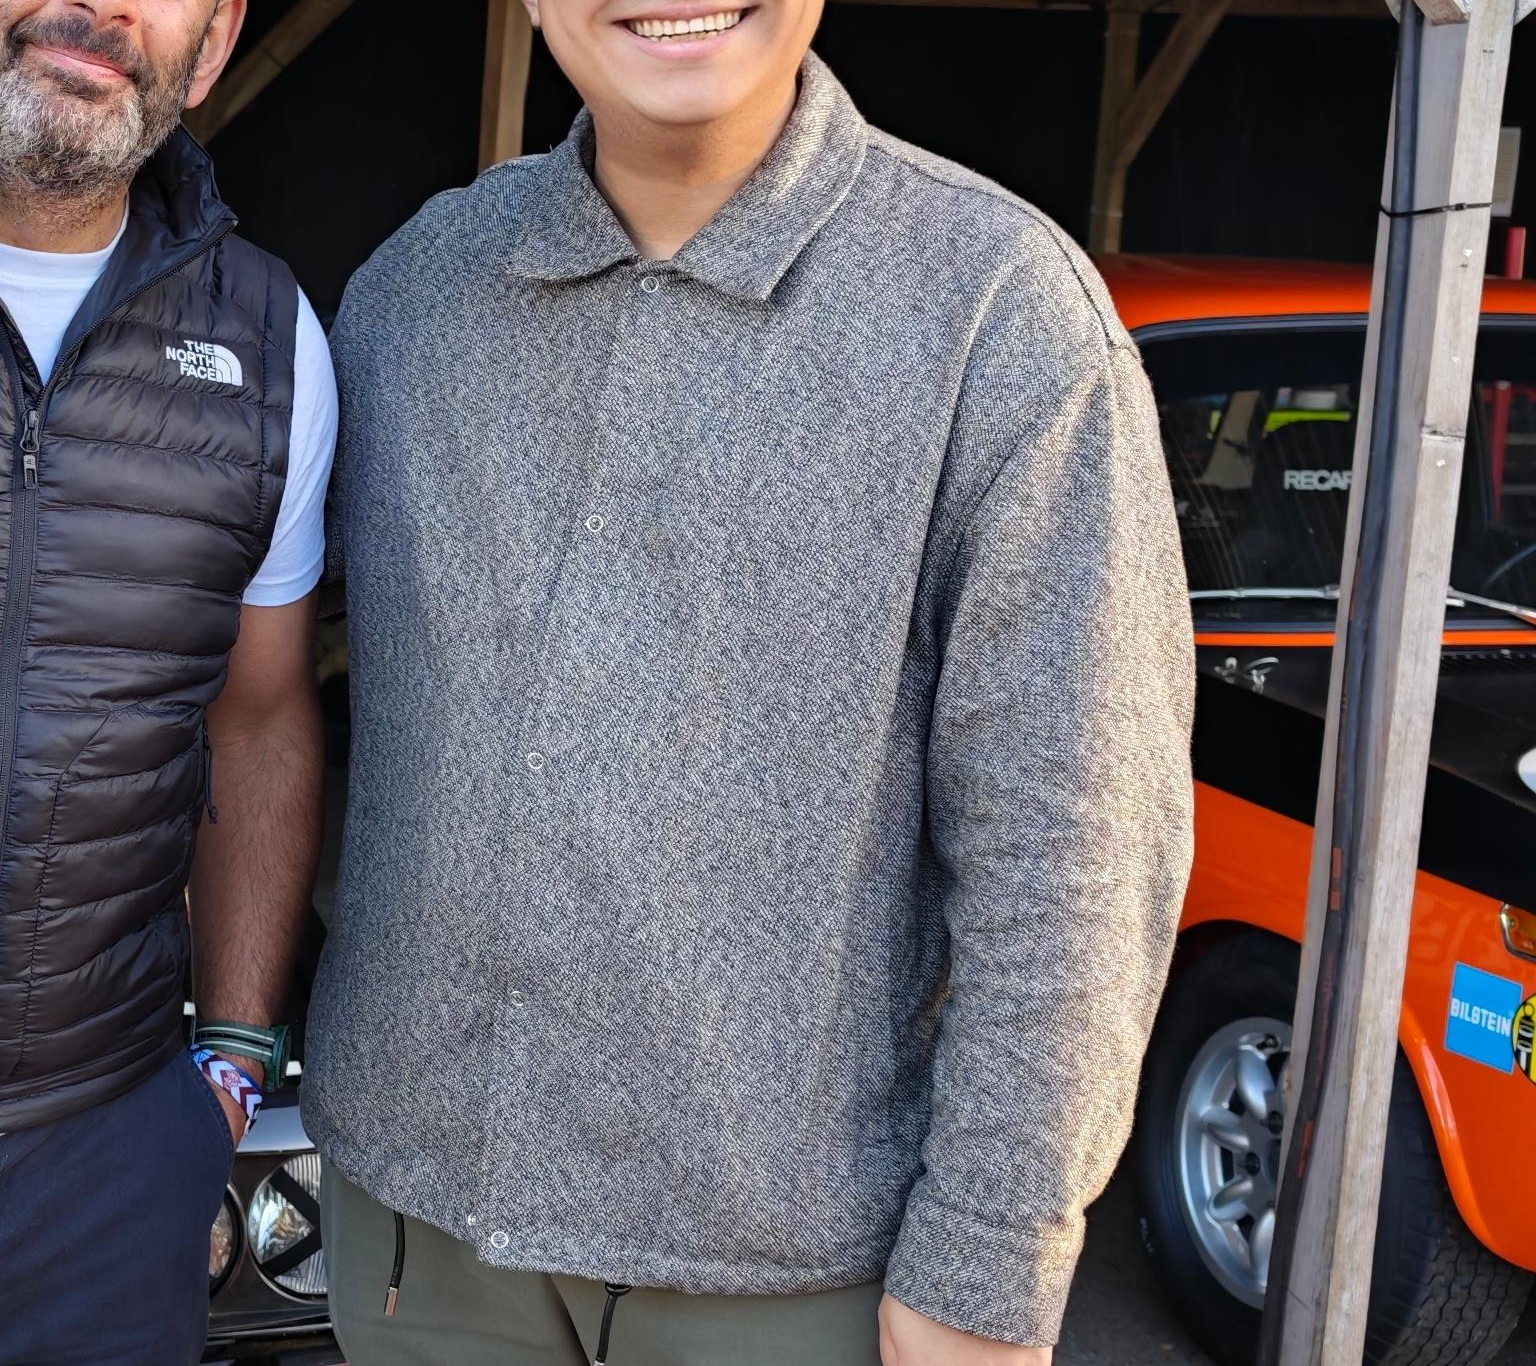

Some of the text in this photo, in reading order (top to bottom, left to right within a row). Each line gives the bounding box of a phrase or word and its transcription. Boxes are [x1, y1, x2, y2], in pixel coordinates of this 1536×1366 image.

[166, 346, 215, 368] NORTH
[184, 339, 214, 356] THE
[180, 364, 217, 381] FACE
[1450, 998, 1511, 1037] BILSTEIN
